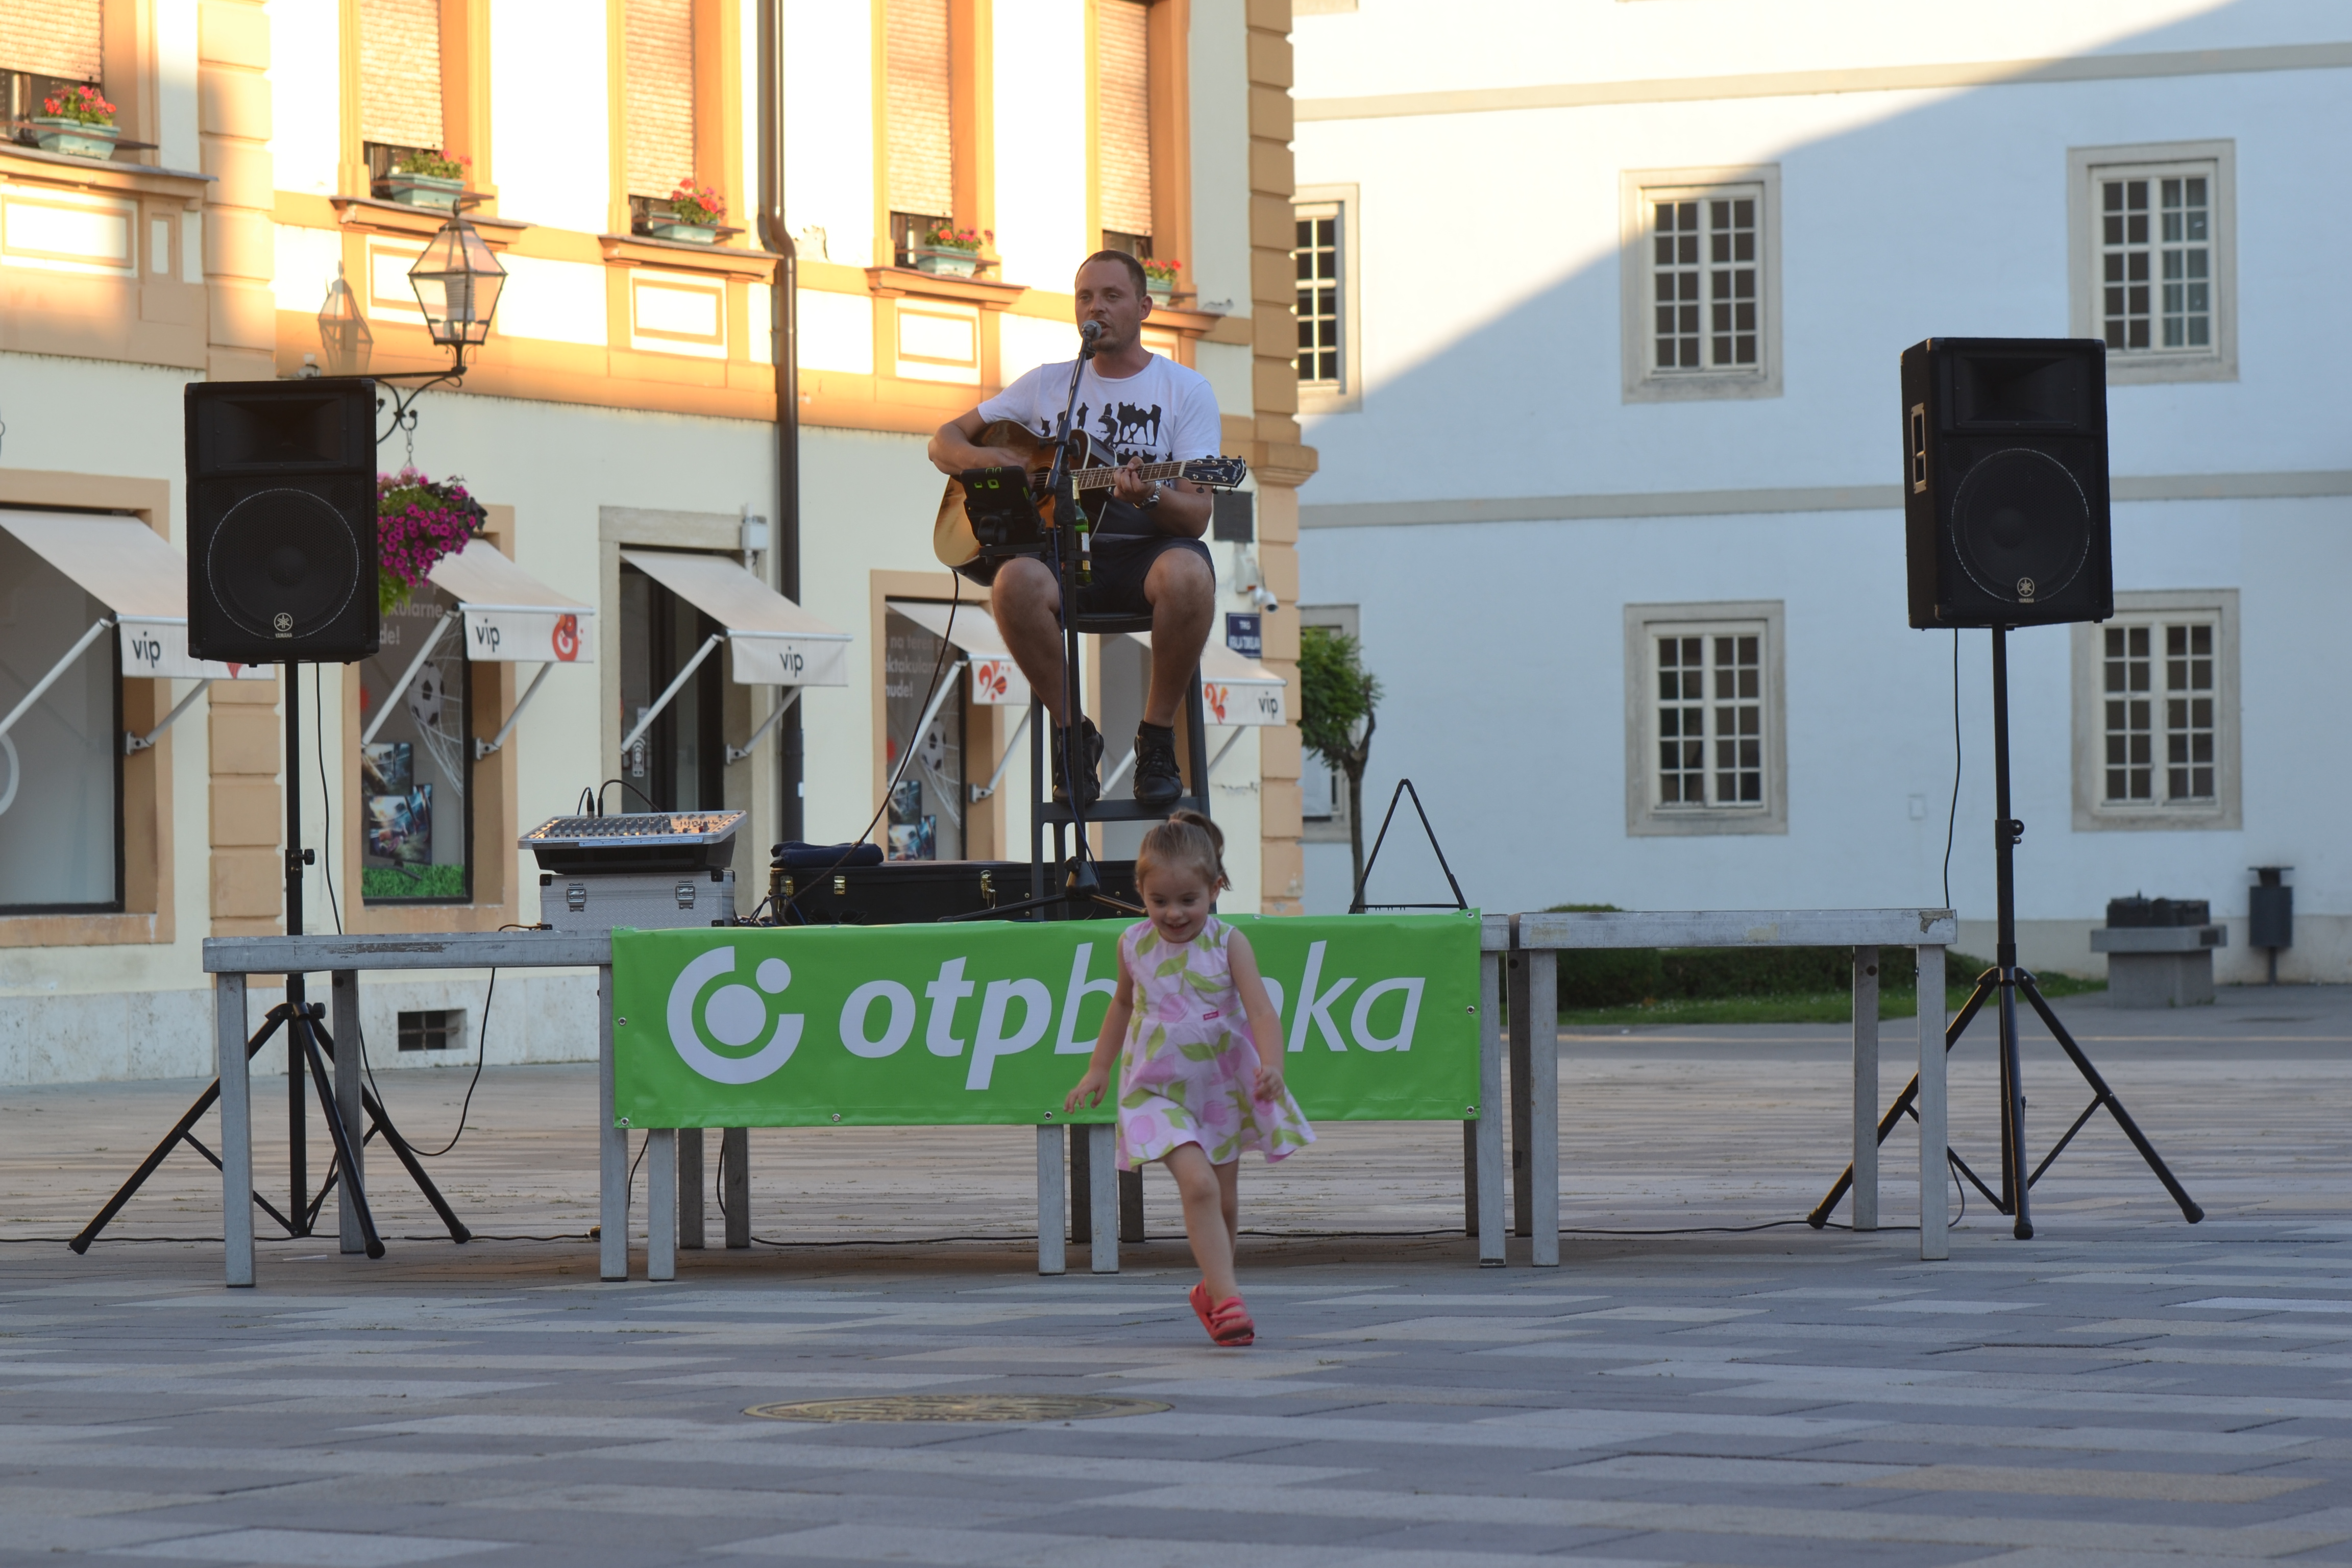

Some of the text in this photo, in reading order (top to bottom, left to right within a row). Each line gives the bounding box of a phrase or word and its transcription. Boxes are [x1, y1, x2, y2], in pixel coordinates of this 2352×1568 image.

[132, 631, 160, 669] vip
[476, 618, 500, 652] vip
[779, 646, 803, 678] vip
[1258, 691, 1278, 720] vip
[839, 940, 1426, 1090] otpbka
